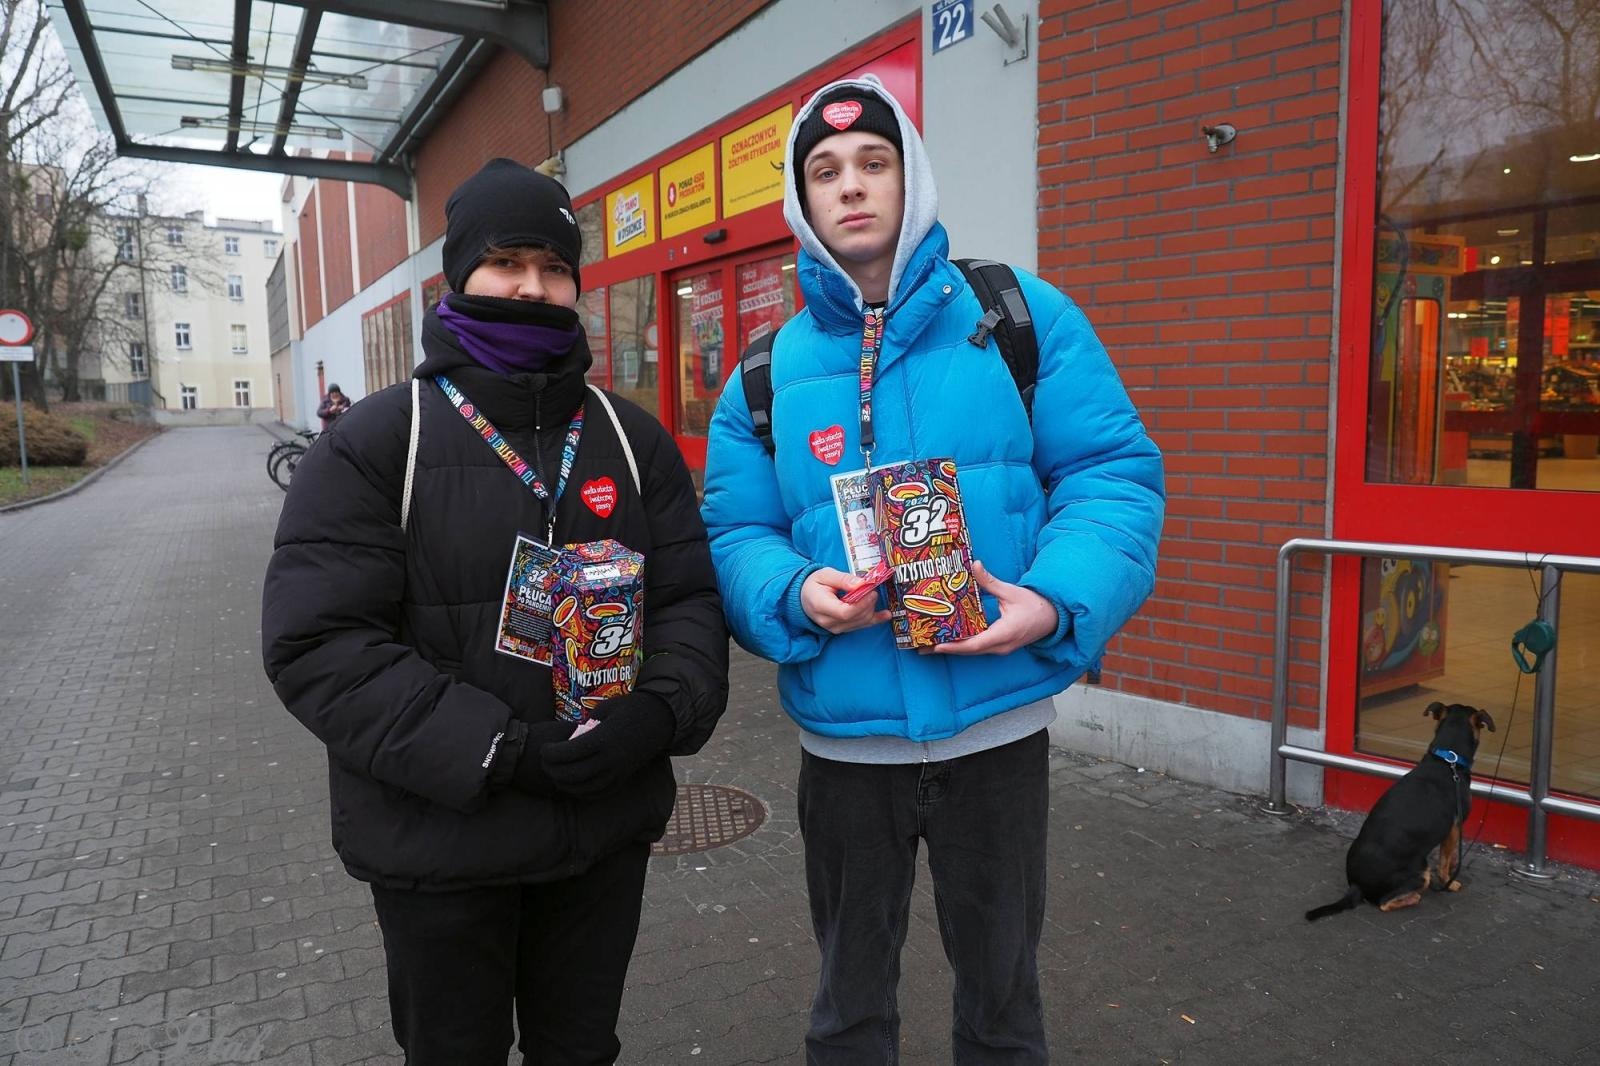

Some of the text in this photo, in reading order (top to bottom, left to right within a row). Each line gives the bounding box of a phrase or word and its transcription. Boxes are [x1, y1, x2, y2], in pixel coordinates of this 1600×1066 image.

[939, 3, 965, 48] 22
[860, 353, 874, 391] WSZYSTKO
[861, 391, 871, 403] TU
[481, 425, 499, 443] GRA
[492, 438, 528, 476] WSZYSTKO
[521, 470, 536, 485] TU
[843, 484, 869, 496] PŁUC
[905, 496, 928, 507] 2024
[902, 497, 948, 545] 32
[529, 569, 548, 583] 32
[519, 586, 552, 606] PŁUCA
[576, 667, 618, 687] WSZYSTKO
